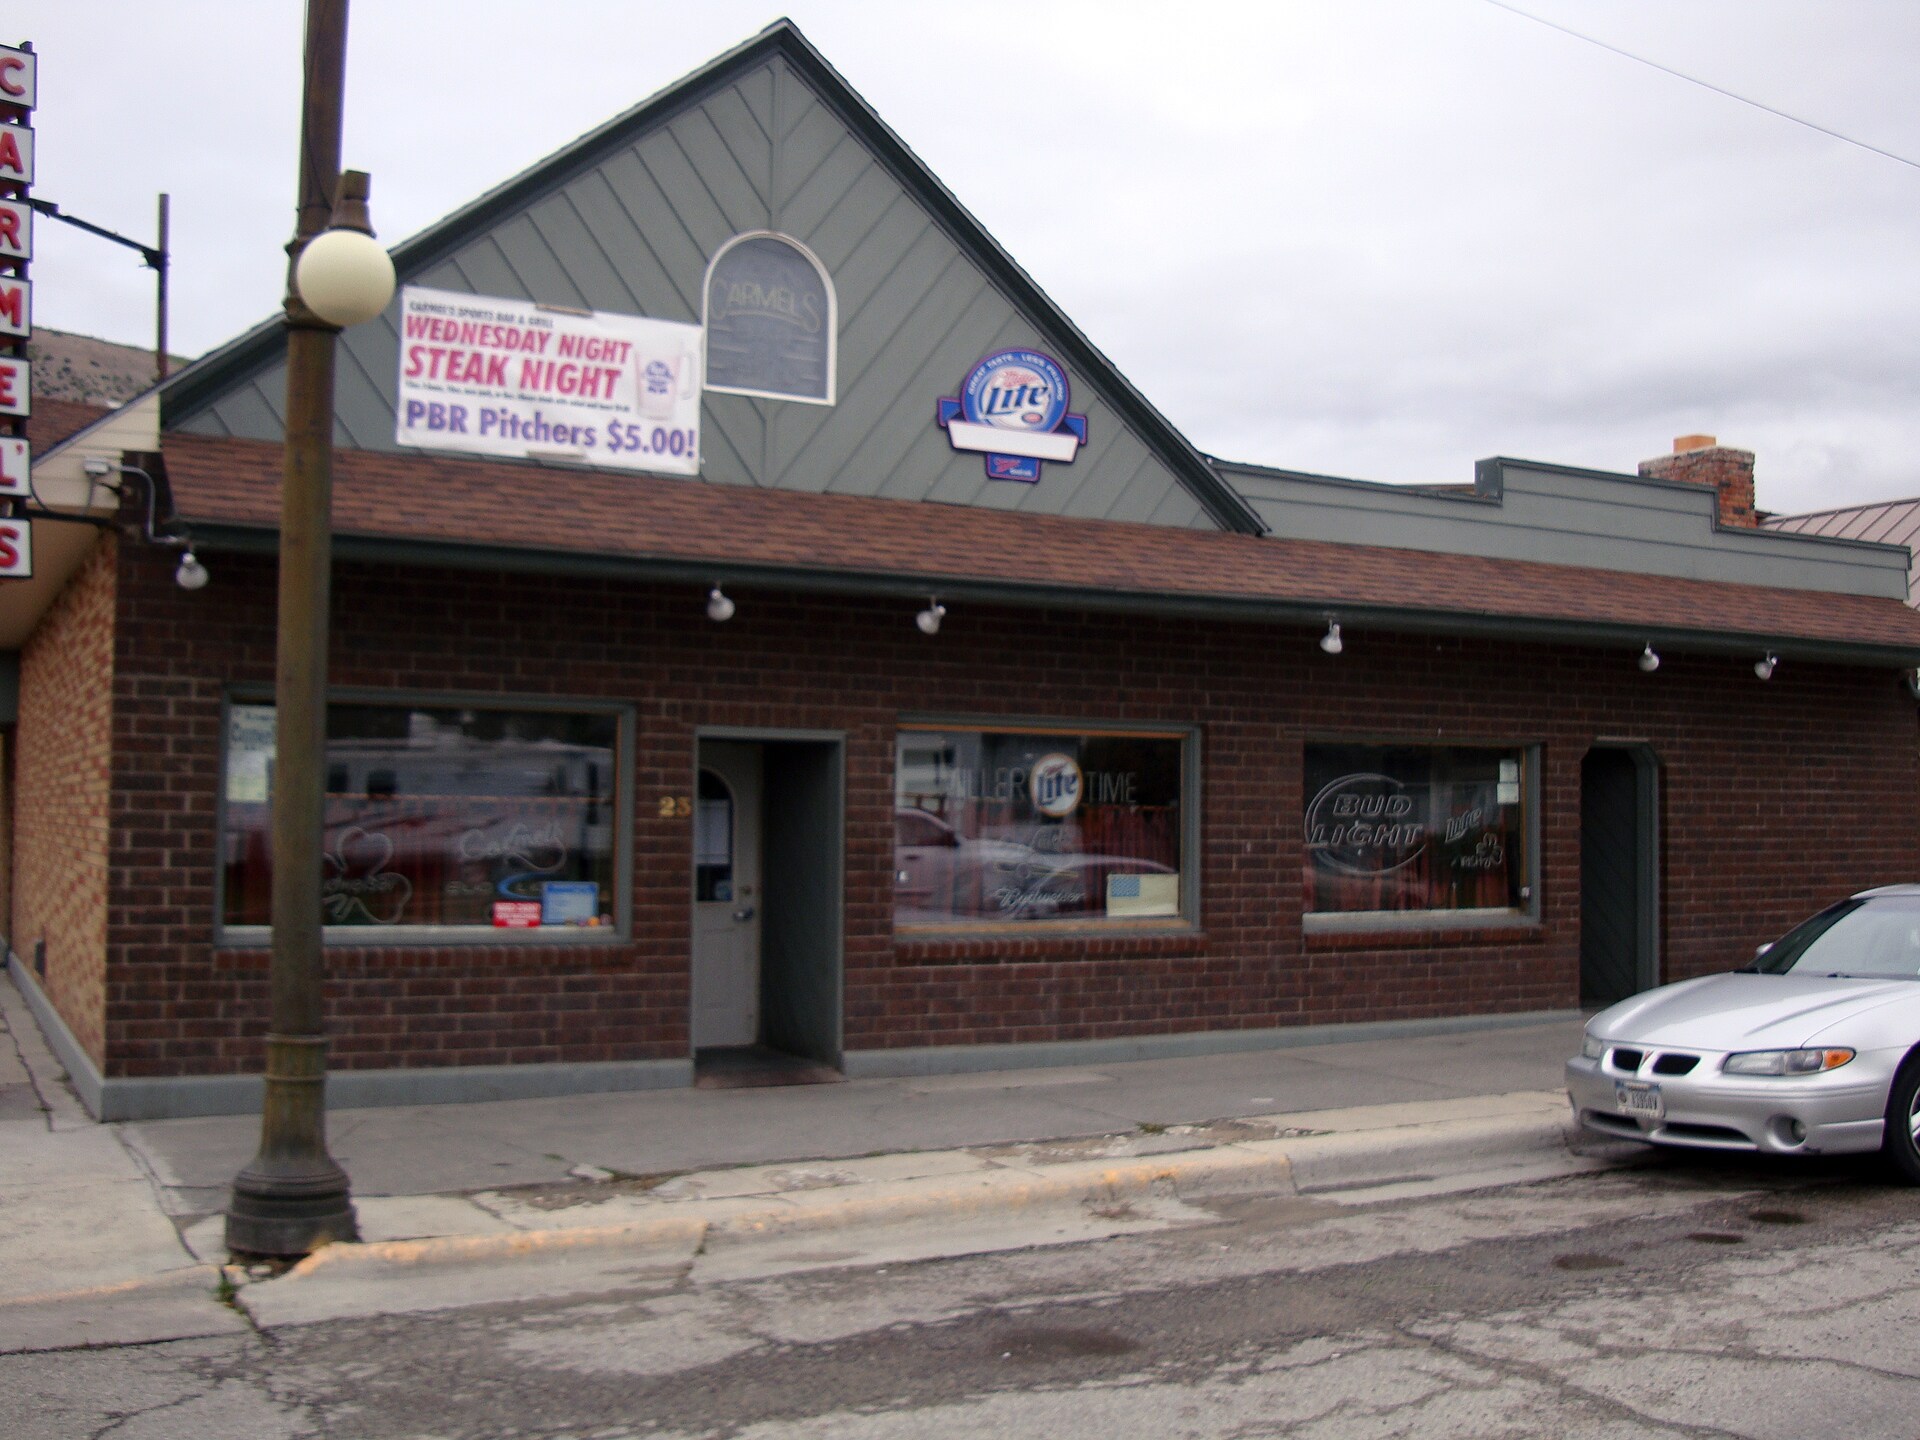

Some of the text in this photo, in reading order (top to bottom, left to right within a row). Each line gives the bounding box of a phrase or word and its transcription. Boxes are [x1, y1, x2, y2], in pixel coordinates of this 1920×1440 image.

[406, 314, 633, 364] WEDNESDAY NIGHT
[405, 345, 510, 387] STEAK
[520, 358, 622, 399] NIGHT
[984, 384, 1049, 415] Lite
[406, 399, 695, 458] PBR Pitchers $5.00!
[1037, 772, 1079, 807] Lite
[1087, 770, 1138, 803] TIME
[1332, 794, 1413, 818] BUD
[1306, 822, 1424, 849] LIGHT
